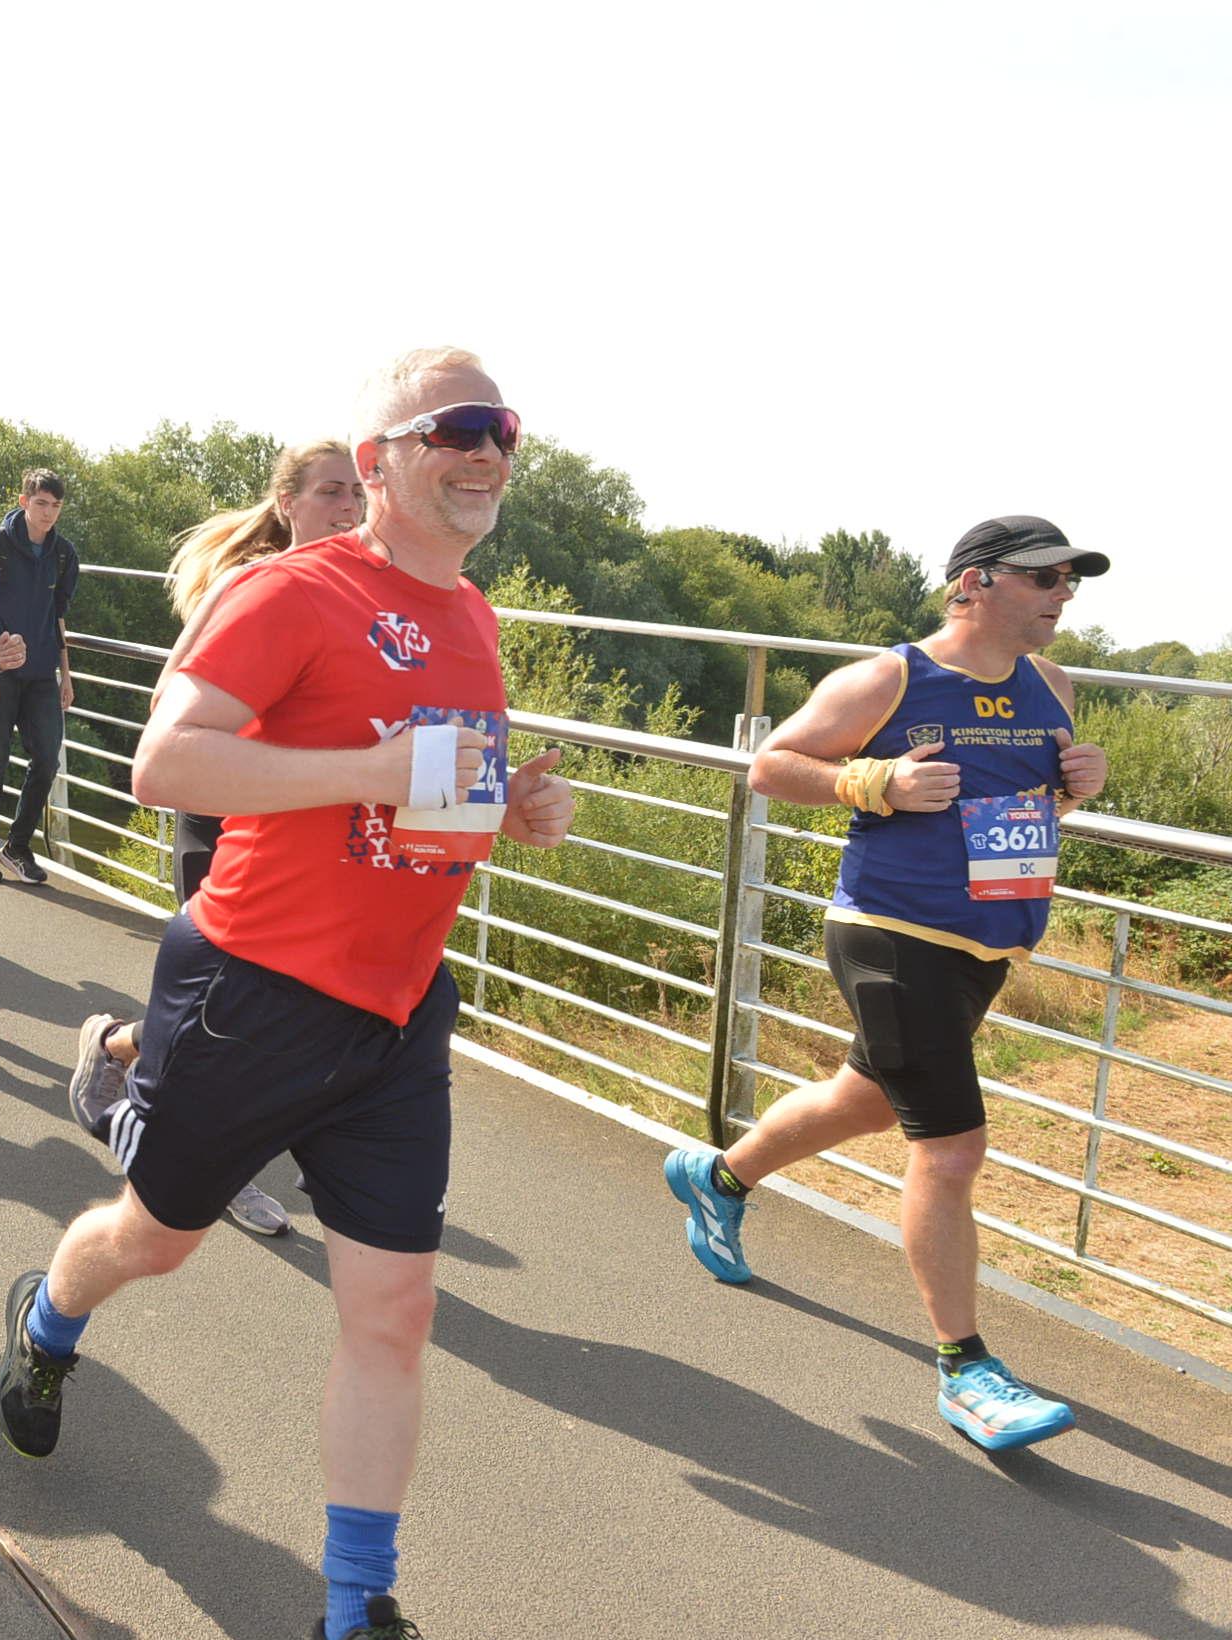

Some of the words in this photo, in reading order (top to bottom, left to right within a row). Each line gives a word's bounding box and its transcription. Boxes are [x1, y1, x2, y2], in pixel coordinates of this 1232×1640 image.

[974, 696, 1015, 719] DC
[950, 727, 1011, 737] KINGSTON
[1013, 728, 1046, 737] UPON
[954, 737, 1012, 746] ATHLETIC
[1013, 738, 1044, 746] CLUB
[988, 825, 1047, 852] 3621
[1019, 862, 1036, 875] DC
